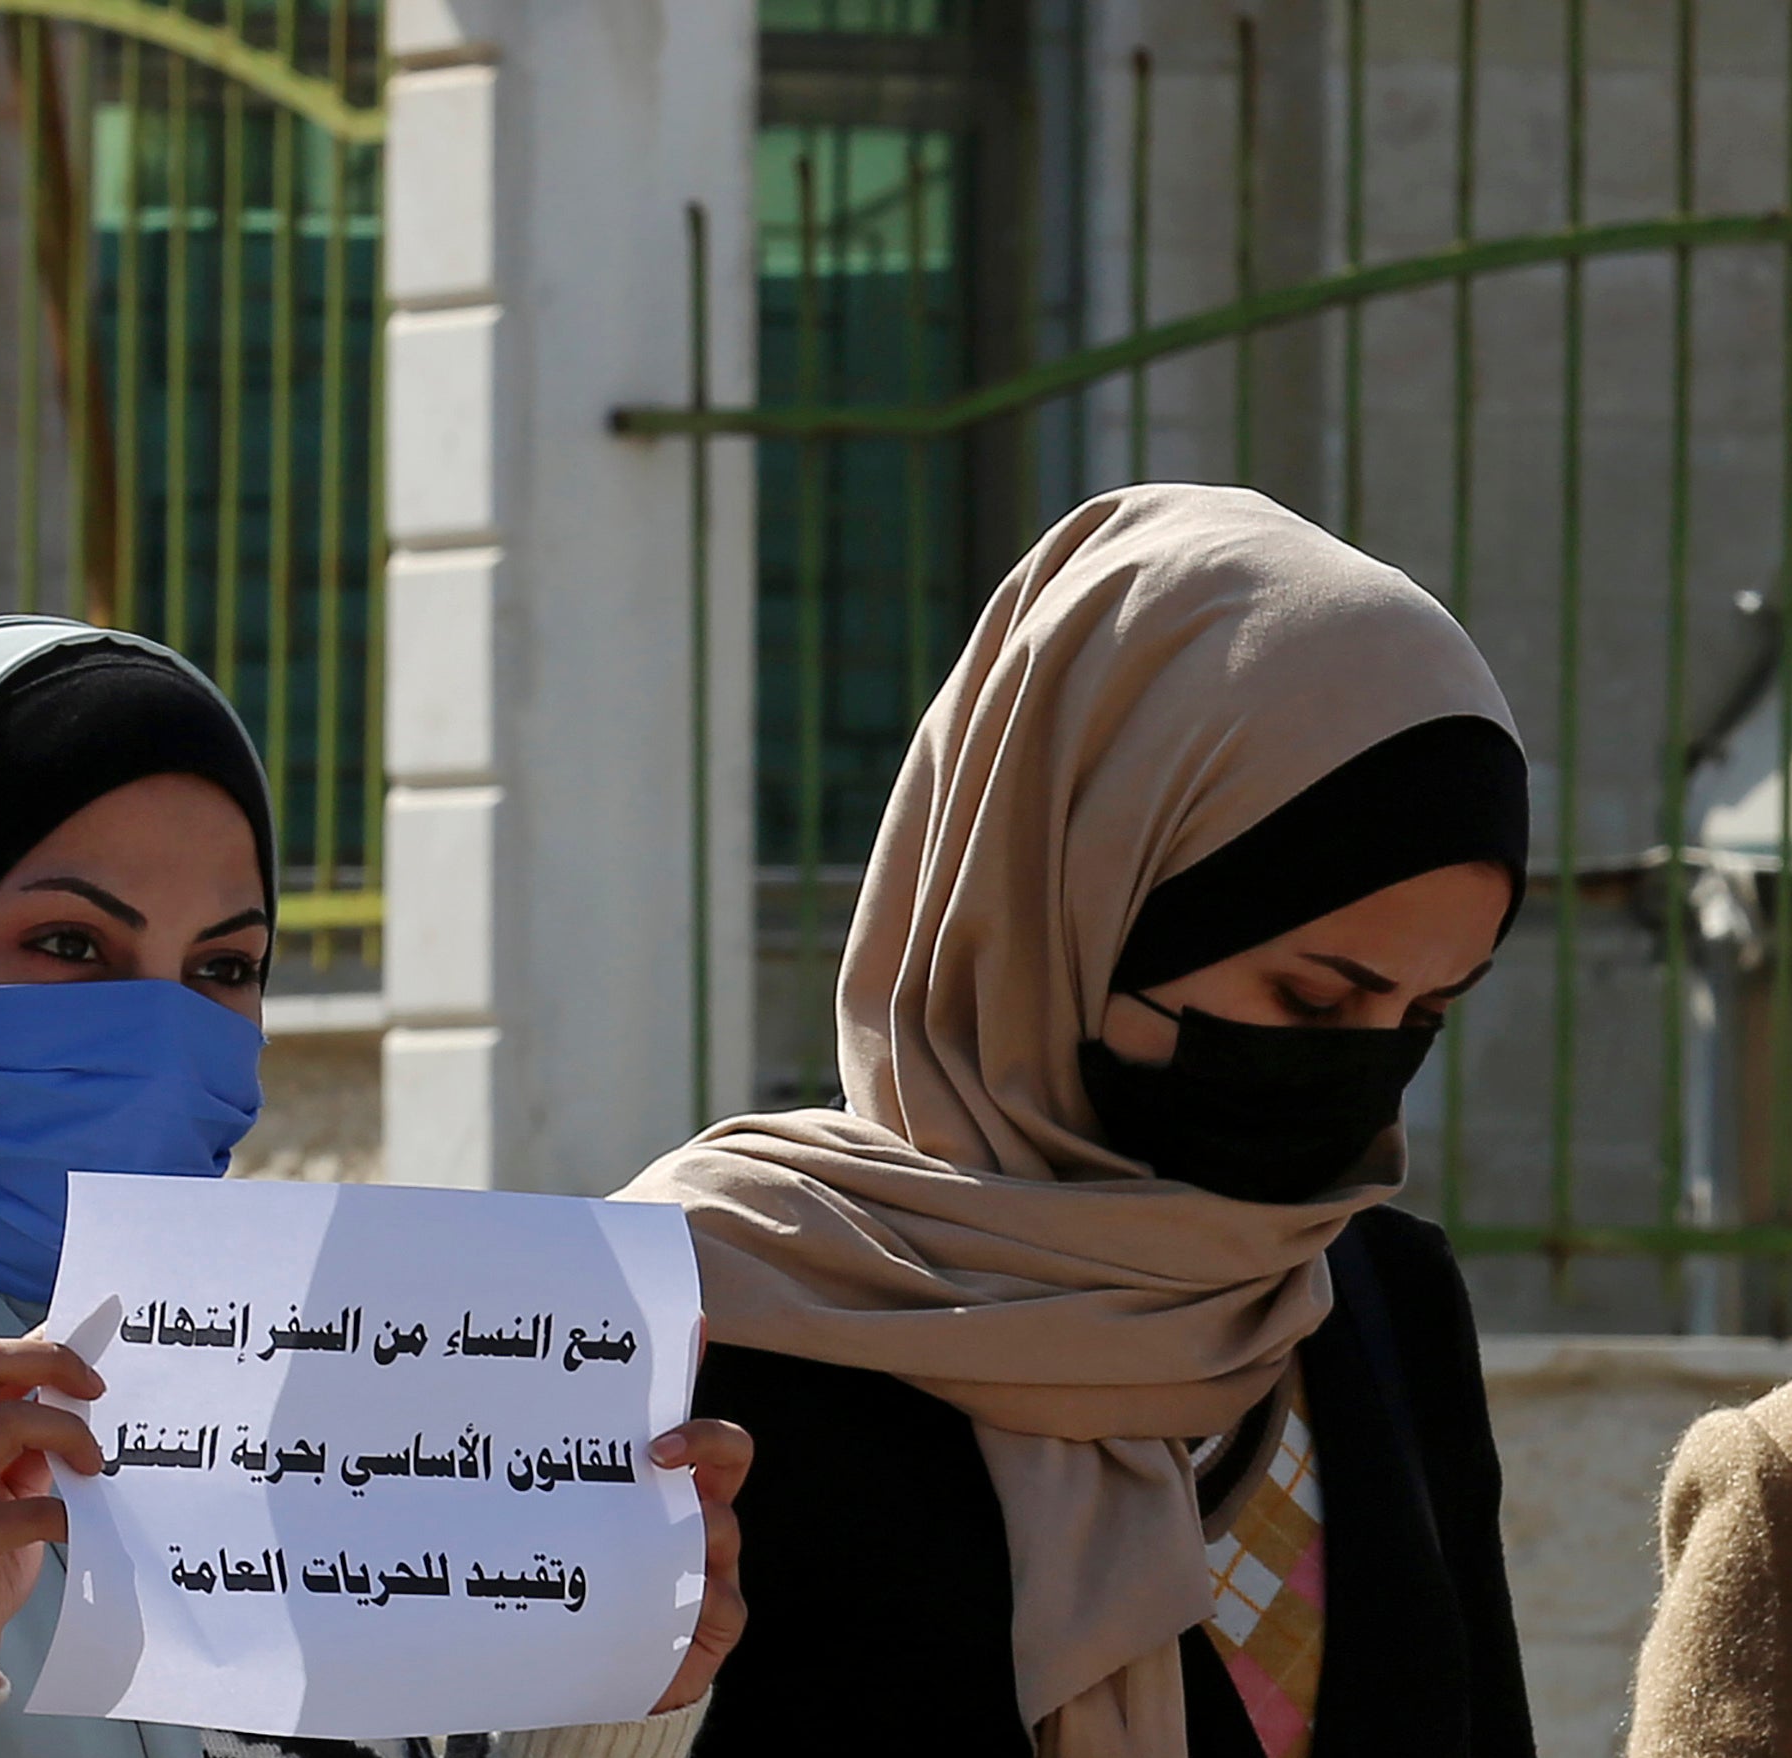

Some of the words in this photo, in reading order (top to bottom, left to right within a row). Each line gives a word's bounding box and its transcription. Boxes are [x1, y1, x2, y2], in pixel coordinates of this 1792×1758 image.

[120, 1300, 250, 1363] إنتهاك
[256, 1303, 362, 1361] السفر
[373, 1319, 428, 1366] من
[443, 1309, 553, 1360] النساء
[563, 1318, 637, 1372] منع
[99, 1421, 219, 1477] التنقل
[230, 1424, 326, 1485] بحرية
[340, 1423, 492, 1497] الأساسي
[506, 1435, 636, 1492] للقانون
[169, 1544, 288, 1594] العامة
[302, 1549, 451, 1607] للحريات
[465, 1553, 587, 1613] وتقييد
